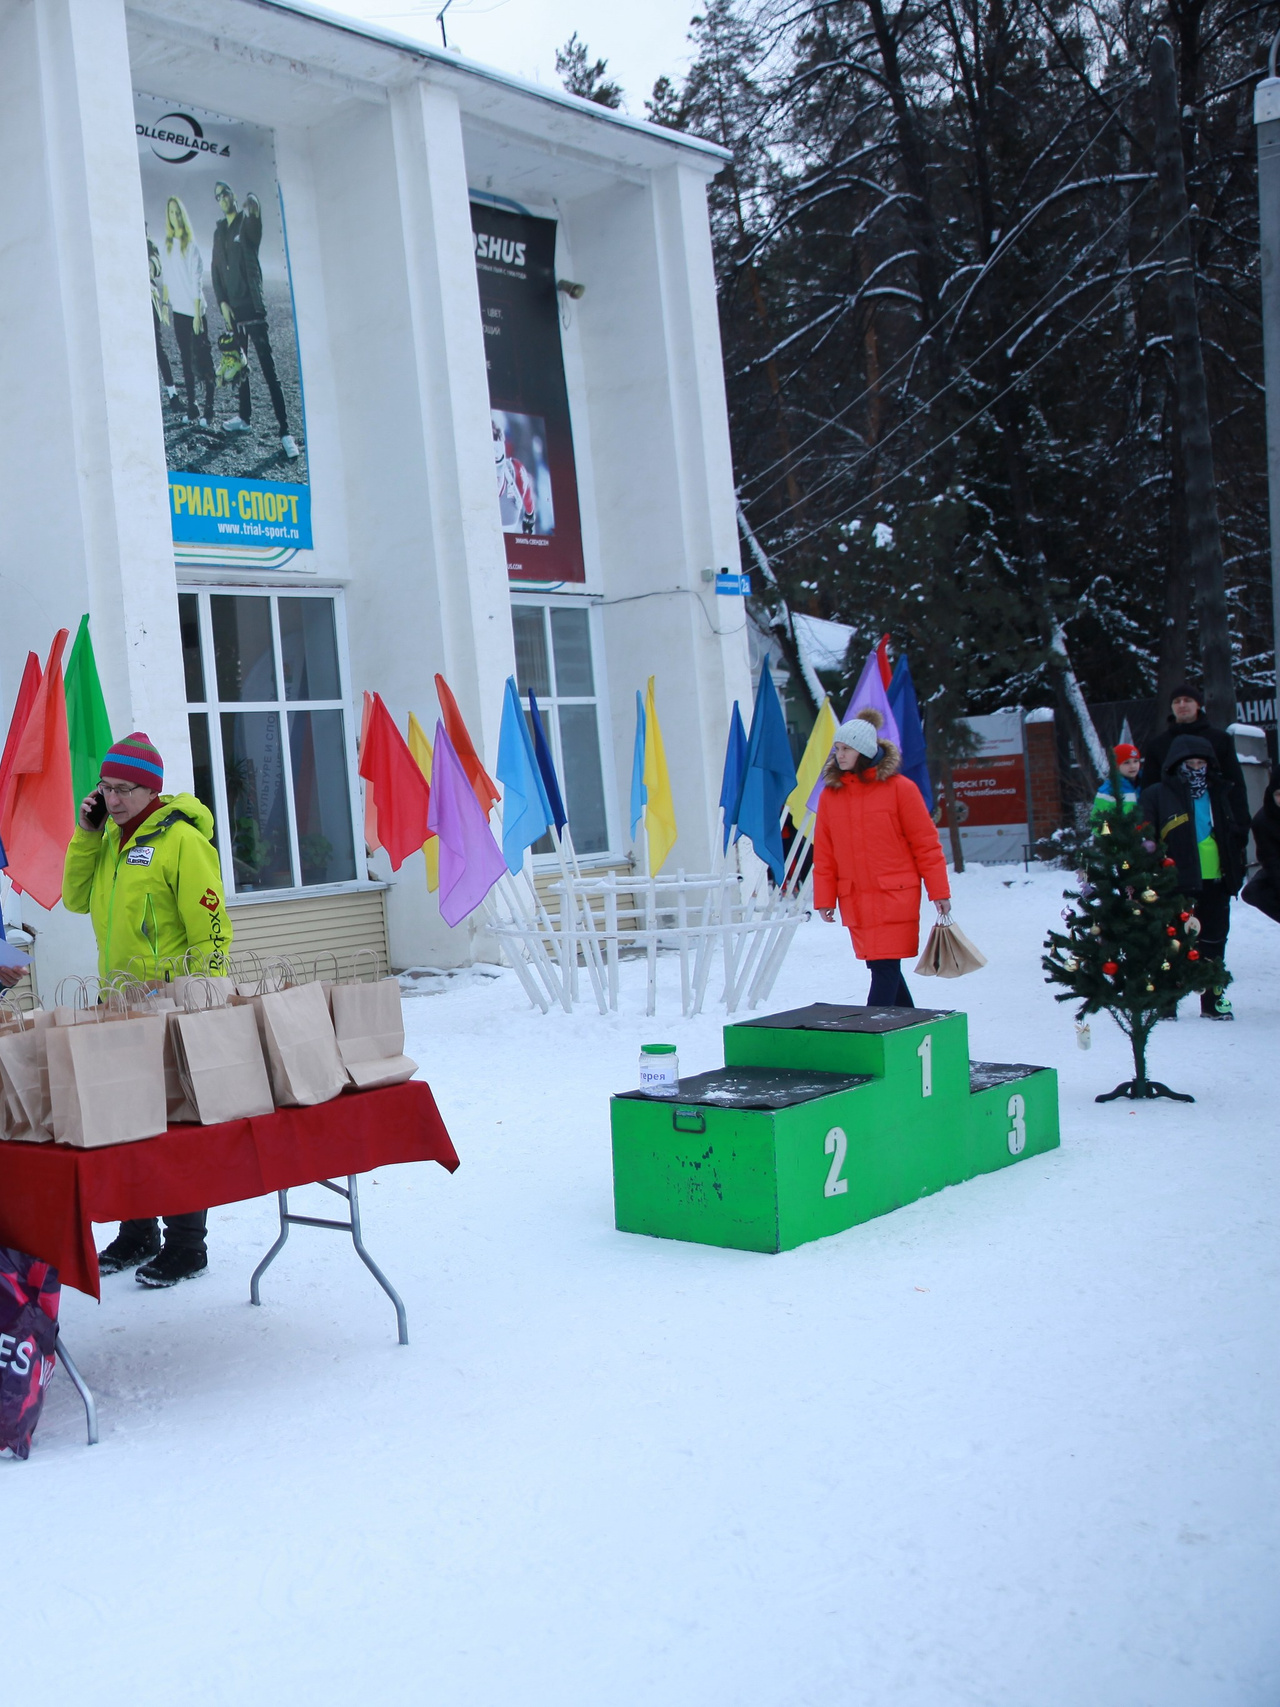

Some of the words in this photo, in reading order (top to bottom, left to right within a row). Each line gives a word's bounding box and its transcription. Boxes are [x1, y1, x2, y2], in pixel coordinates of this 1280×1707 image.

[217, 523, 299, 539] www.trial-sport.ru
[1236, 699, 1277, 723] АНИ
[260, 755, 273, 816] КУЛЬТУРЕ
[964, 787, 1017, 797] Челябинска
[979, 779, 996, 788] ГТО
[917, 1034, 932, 1098] 1
[1007, 1094, 1026, 1155] 3
[824, 1126, 848, 1198] 2
